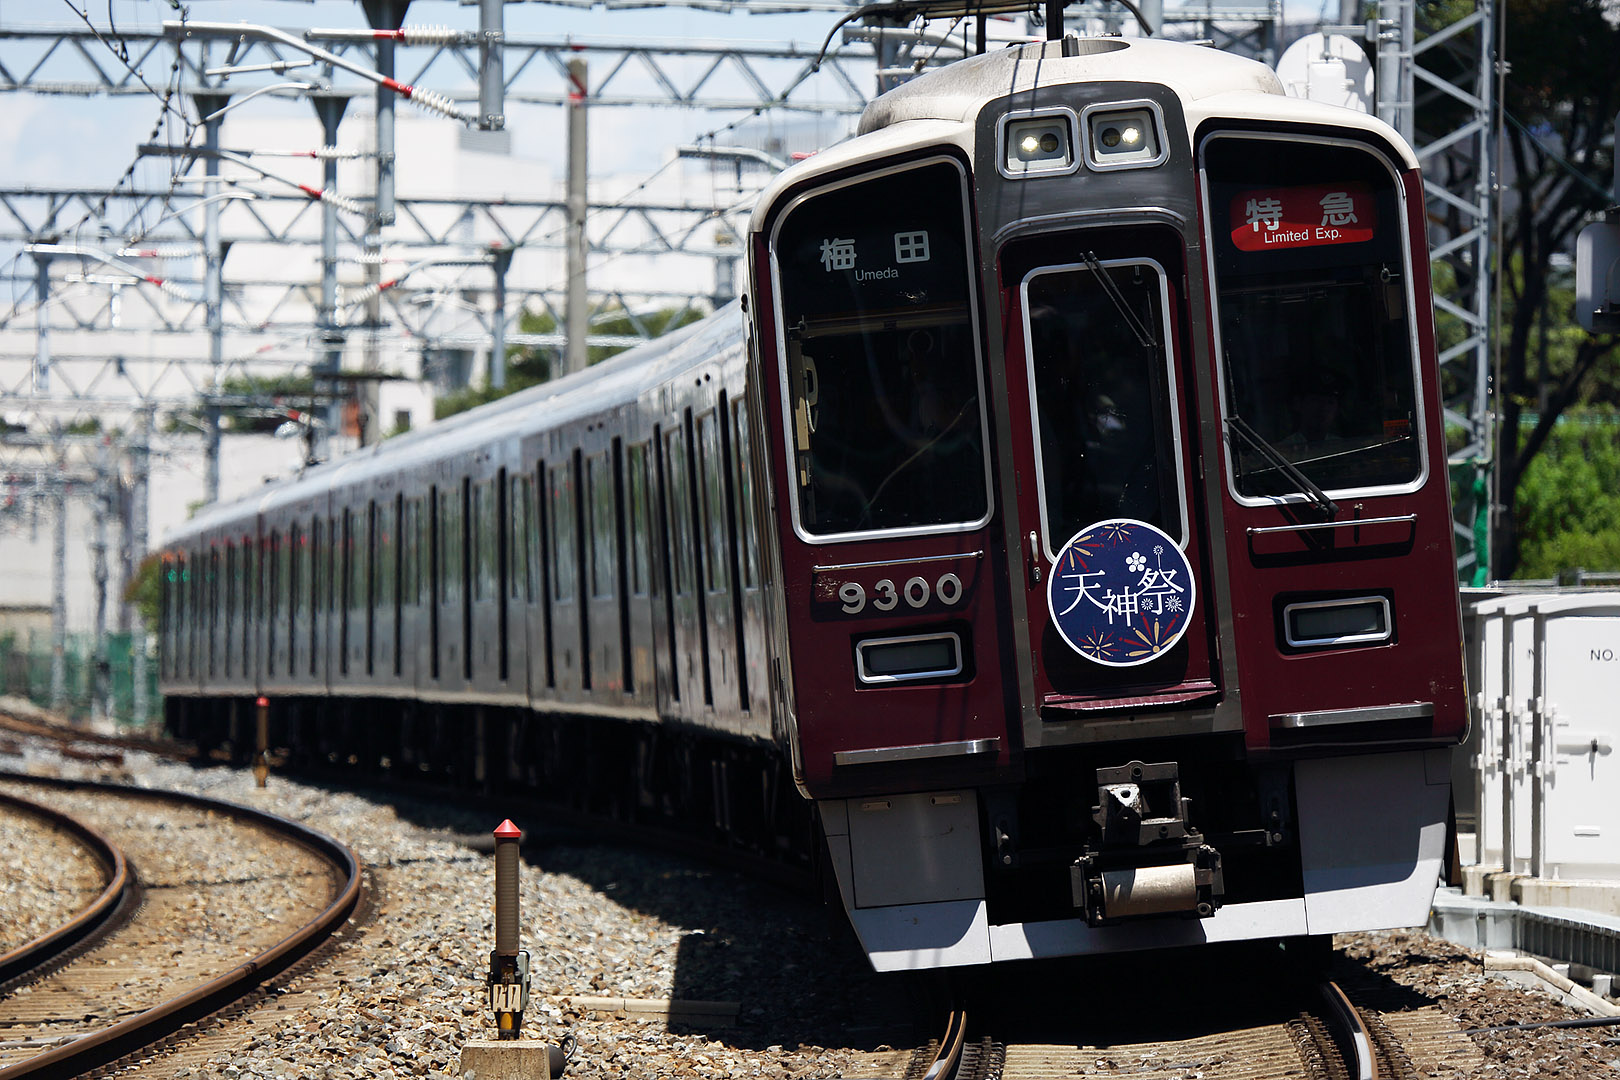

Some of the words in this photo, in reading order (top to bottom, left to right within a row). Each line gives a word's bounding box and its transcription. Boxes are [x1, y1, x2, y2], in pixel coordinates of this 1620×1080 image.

[1245, 192, 1358, 232] 特急
[819, 230, 931, 272] 梅田
[1264, 229, 1309, 244] Limited
[1315, 227, 1342, 241] Exp.
[854, 266, 899, 282] Umeda
[838, 572, 963, 614] 9300
[1059, 567, 1185, 627] 天神祭
[1590, 649, 1618, 662] NO.
